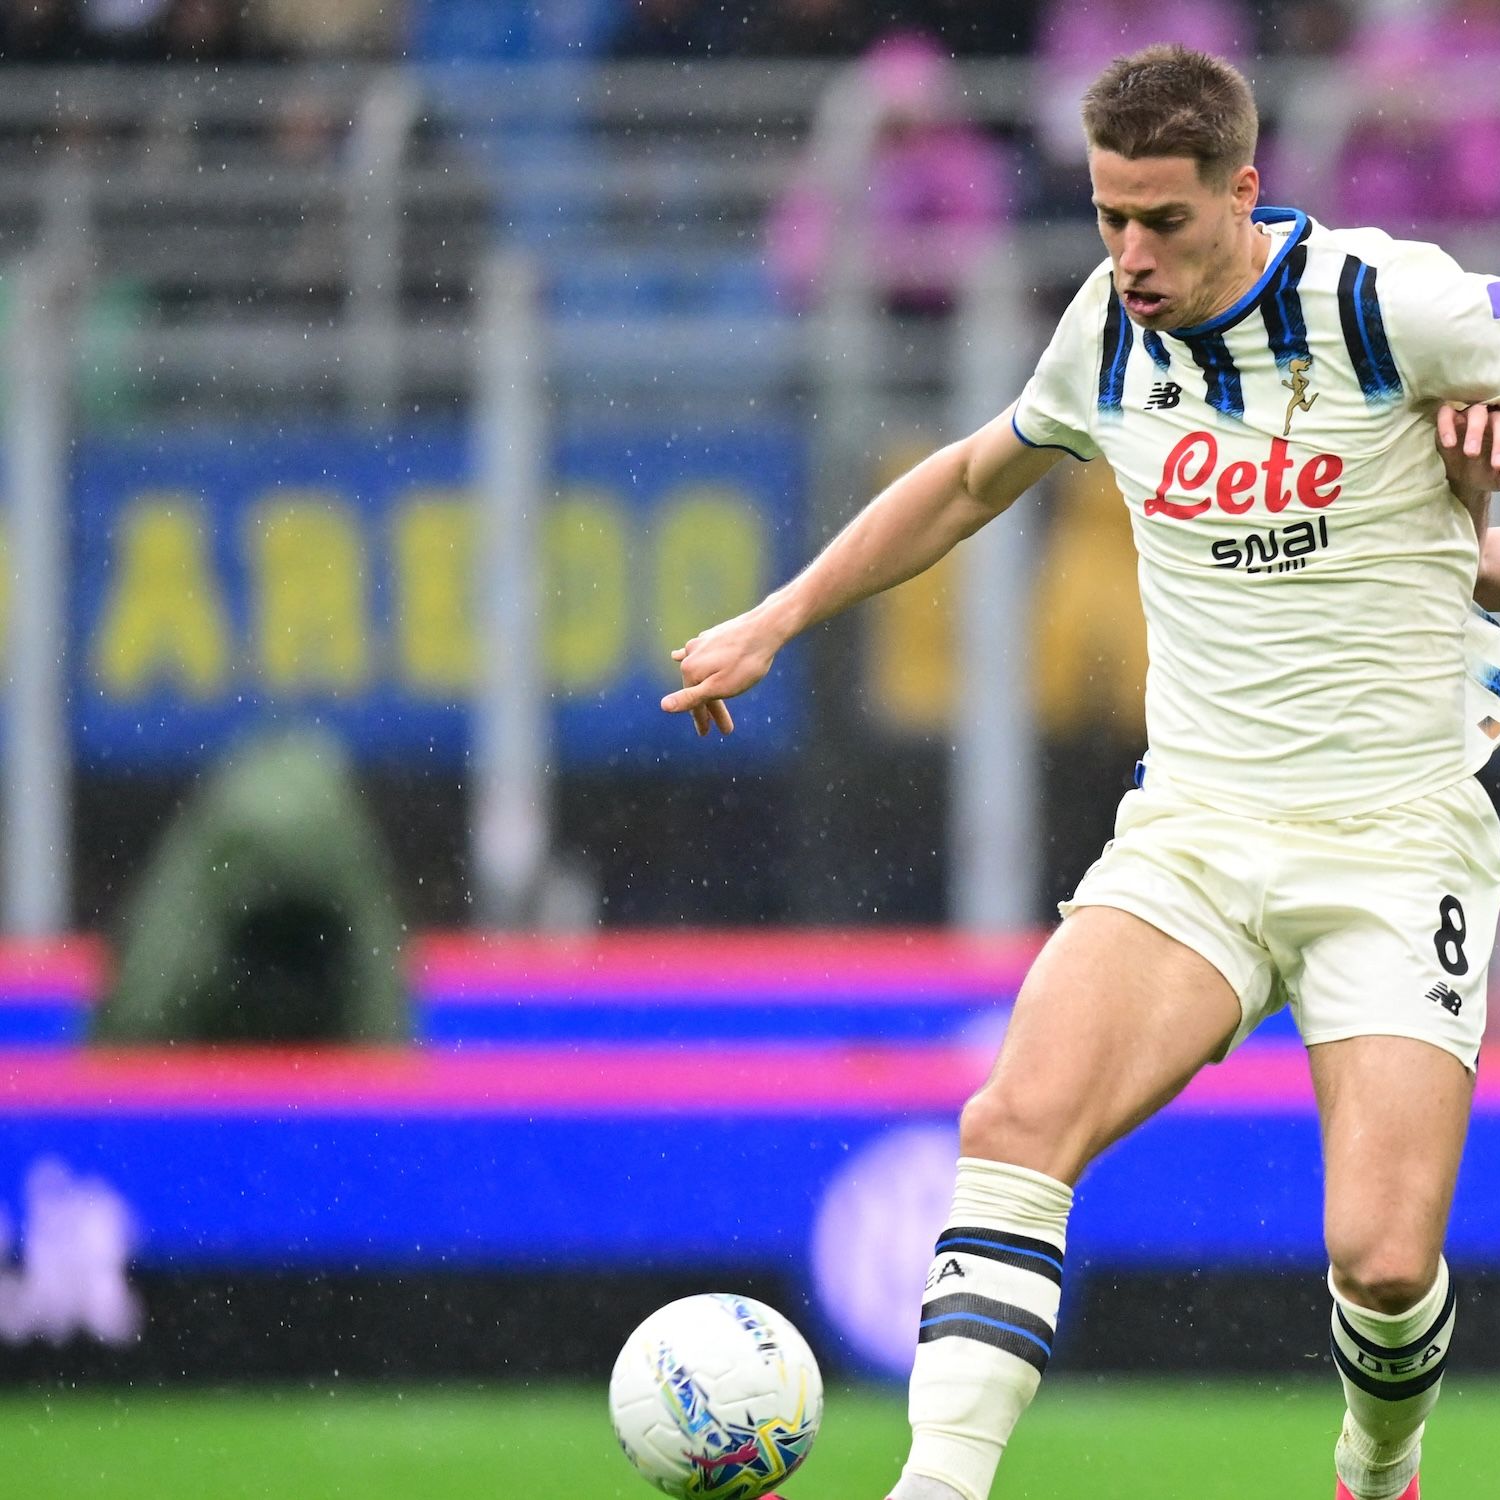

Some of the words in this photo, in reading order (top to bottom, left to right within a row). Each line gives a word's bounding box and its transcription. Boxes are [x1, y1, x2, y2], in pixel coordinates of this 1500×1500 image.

[1144, 431, 1343, 520] Lete
[1434, 894, 1469, 976] 8
[1357, 1345, 1441, 1375] DEA
